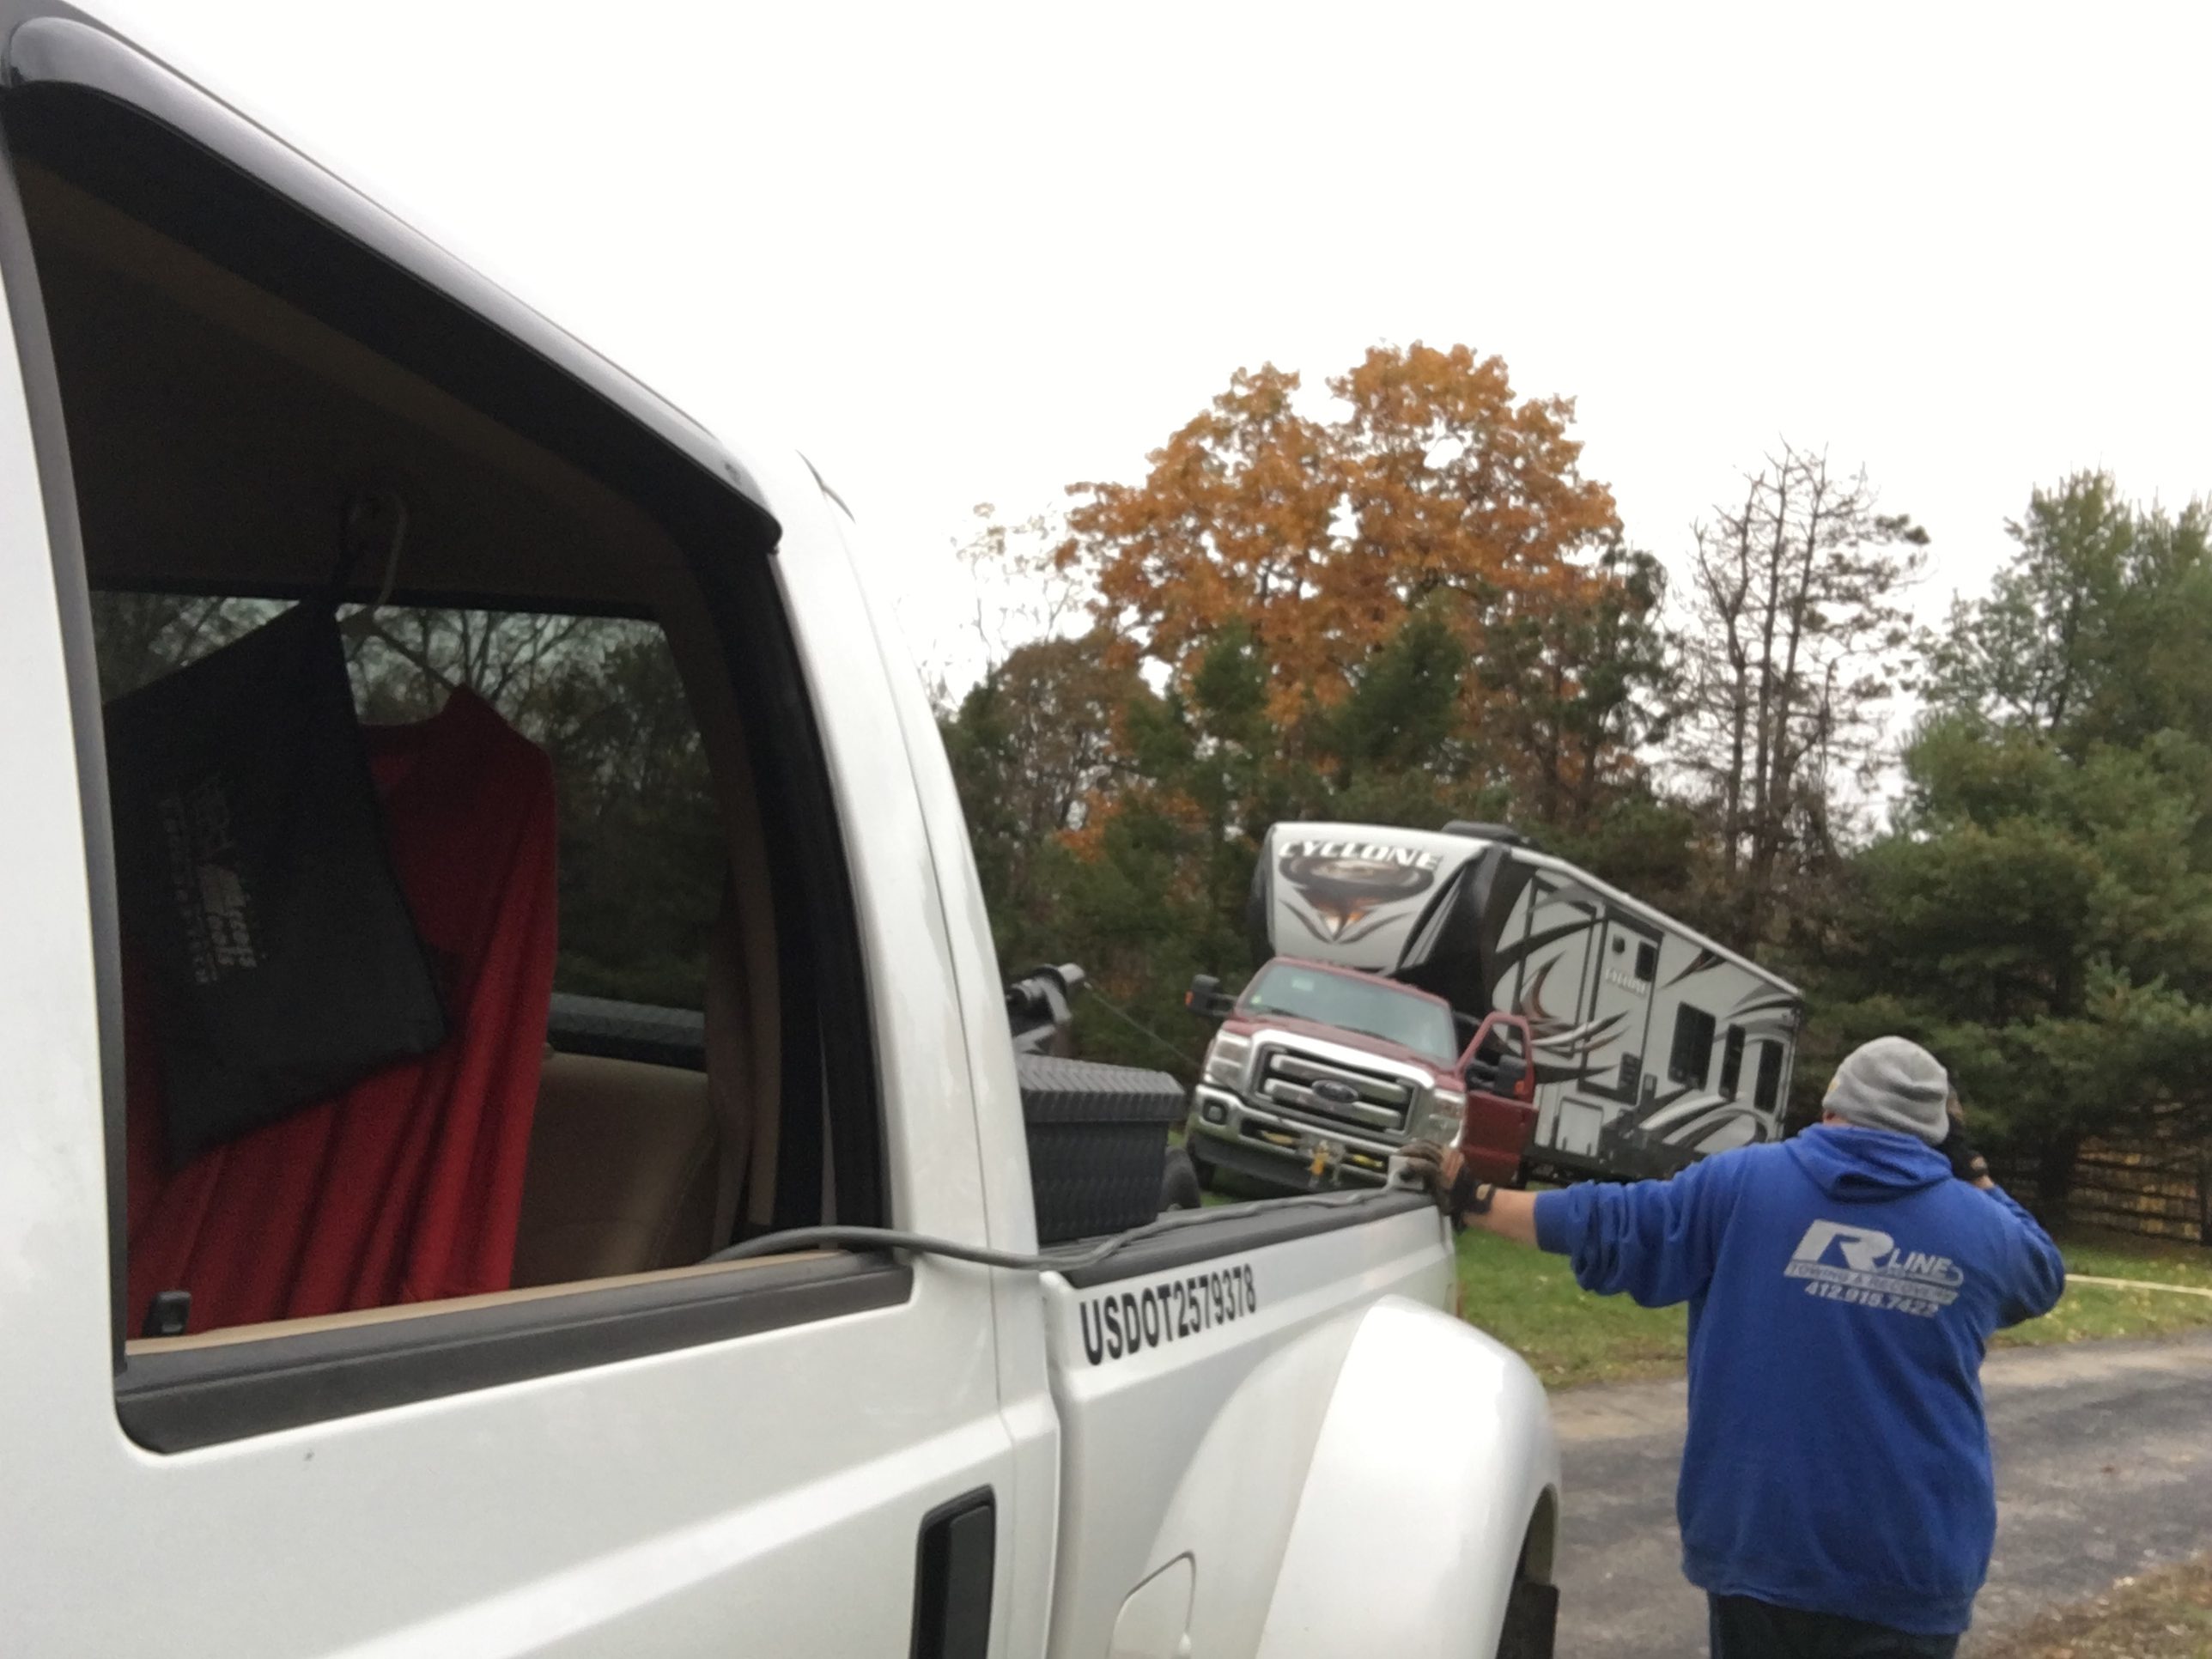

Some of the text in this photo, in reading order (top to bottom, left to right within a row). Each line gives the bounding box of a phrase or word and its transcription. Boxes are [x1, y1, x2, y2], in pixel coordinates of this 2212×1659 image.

[1278, 839, 1443, 871] CYCLONE
[1888, 1248, 1954, 1276] LINE
[1079, 1263, 1256, 1366] USDOT2579378
